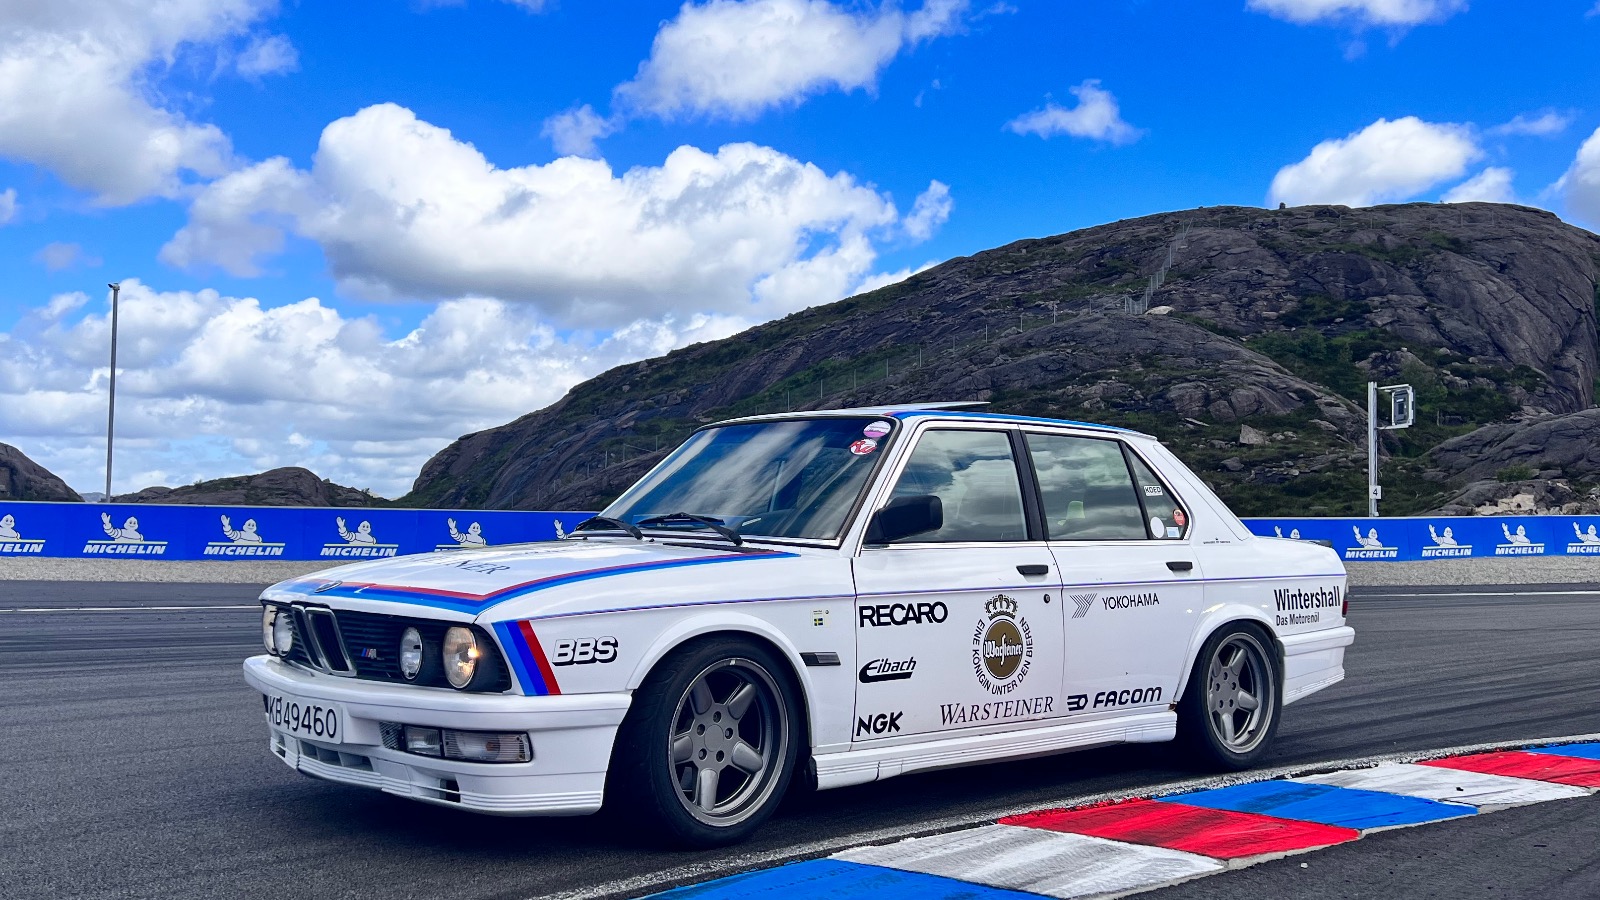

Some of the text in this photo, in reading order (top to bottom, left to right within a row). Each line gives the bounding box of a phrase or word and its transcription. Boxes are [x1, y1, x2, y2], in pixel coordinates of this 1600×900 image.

[1373, 488, 1379, 497] 4
[83, 544, 167, 555] MICHELIN
[203, 546, 285, 557] MICHELIN
[320, 547, 398, 557] MICHELIN
[1345, 550, 1398, 559] MICHELIN
[1422, 548, 1472, 558] MICHELIN
[1495, 546, 1545, 555] MICHELIN
[1566, 546, 1600, 554] MICHE
[1102, 592, 1160, 611] YOKOHAMA
[1273, 585, 1341, 612] Wintershall
[859, 601, 949, 628] RECARO
[1275, 614, 1289, 626] Das
[552, 635, 619, 667] BBS
[972, 616, 1033, 695] EINE KÖNIGIN UNTER DEN BIEREN
[859, 656, 917, 684] Eibach
[1093, 686, 1162, 708] FACOM
[856, 710, 904, 737] NGK
